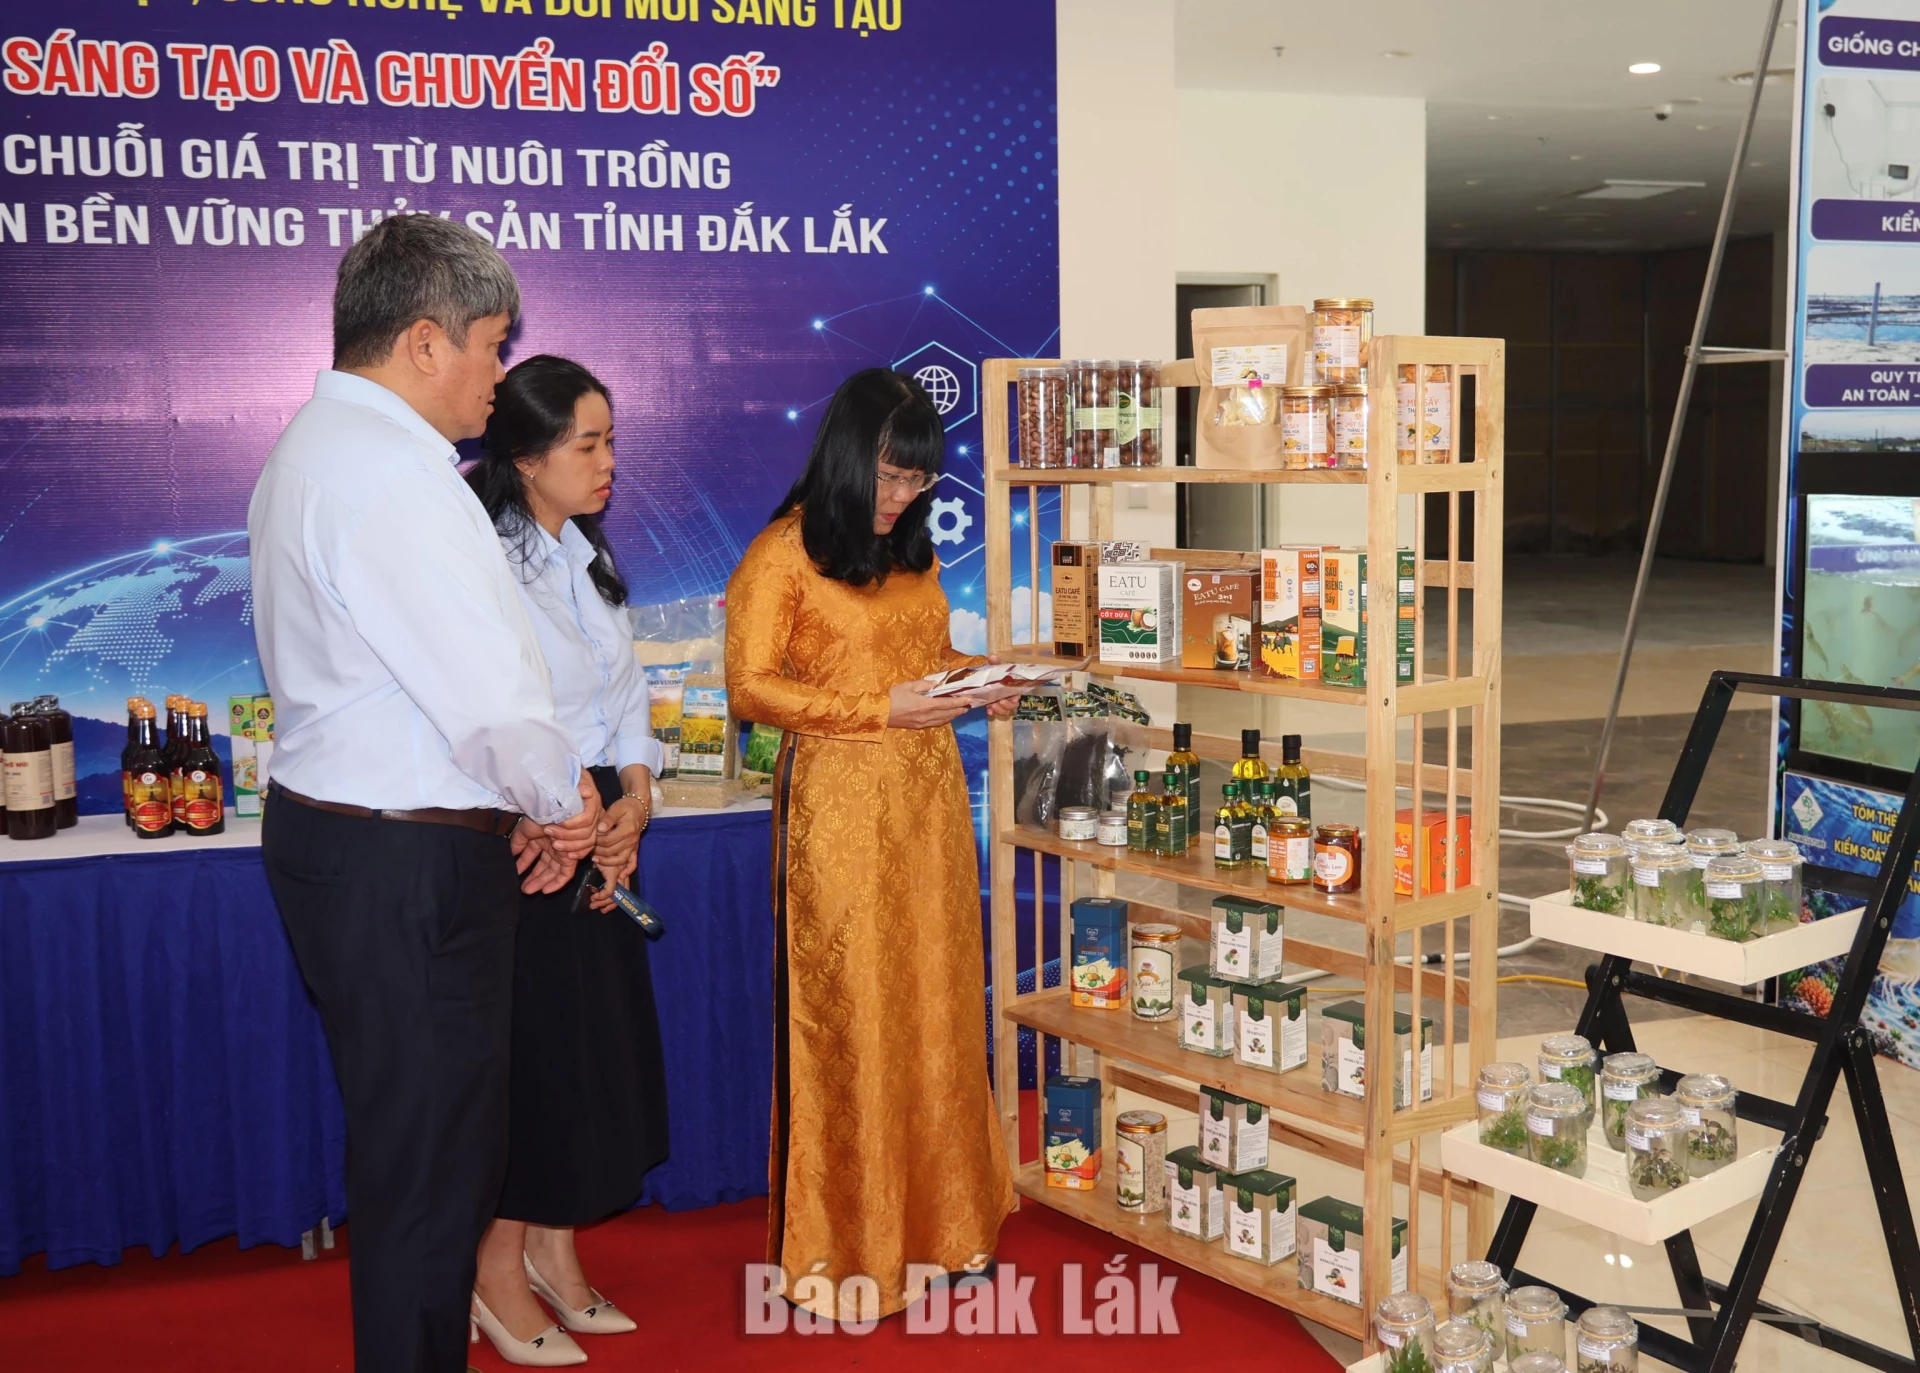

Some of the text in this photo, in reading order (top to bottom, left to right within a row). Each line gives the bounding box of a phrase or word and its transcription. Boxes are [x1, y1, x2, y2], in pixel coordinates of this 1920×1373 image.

[1828, 31, 1894, 55] GIỐNG
[2, 28, 160, 98] SÁNG
[167, 41, 281, 111] TẠO
[288, 39, 368, 105] VÀ
[376, 37, 586, 112] CHUYỂN
[593, 41, 680, 115] ĐỔI
[4, 122, 731, 190] CHUỖI GIÁ TRỊ TỪ NUÔI TRỒNG
[45, 192, 149, 245] BỀN
[166, 198, 304, 246] VỮNG
[465, 200, 560, 250] SẢN
[574, 202, 684, 252] TỈNH
[697, 202, 791, 253] ĐẮK
[803, 203, 889, 254] LẮK
[1870, 371, 1904, 383] QUY
[1842, 389, 1865, 401] AN
[1867, 386, 1910, 401] TOÀN
[1109, 575, 1147, 588] EATU
[1193, 587, 1219, 601] EATU
[1852, 801, 1875, 822] TÔM
[1834, 836, 1859, 857] KIỂM
